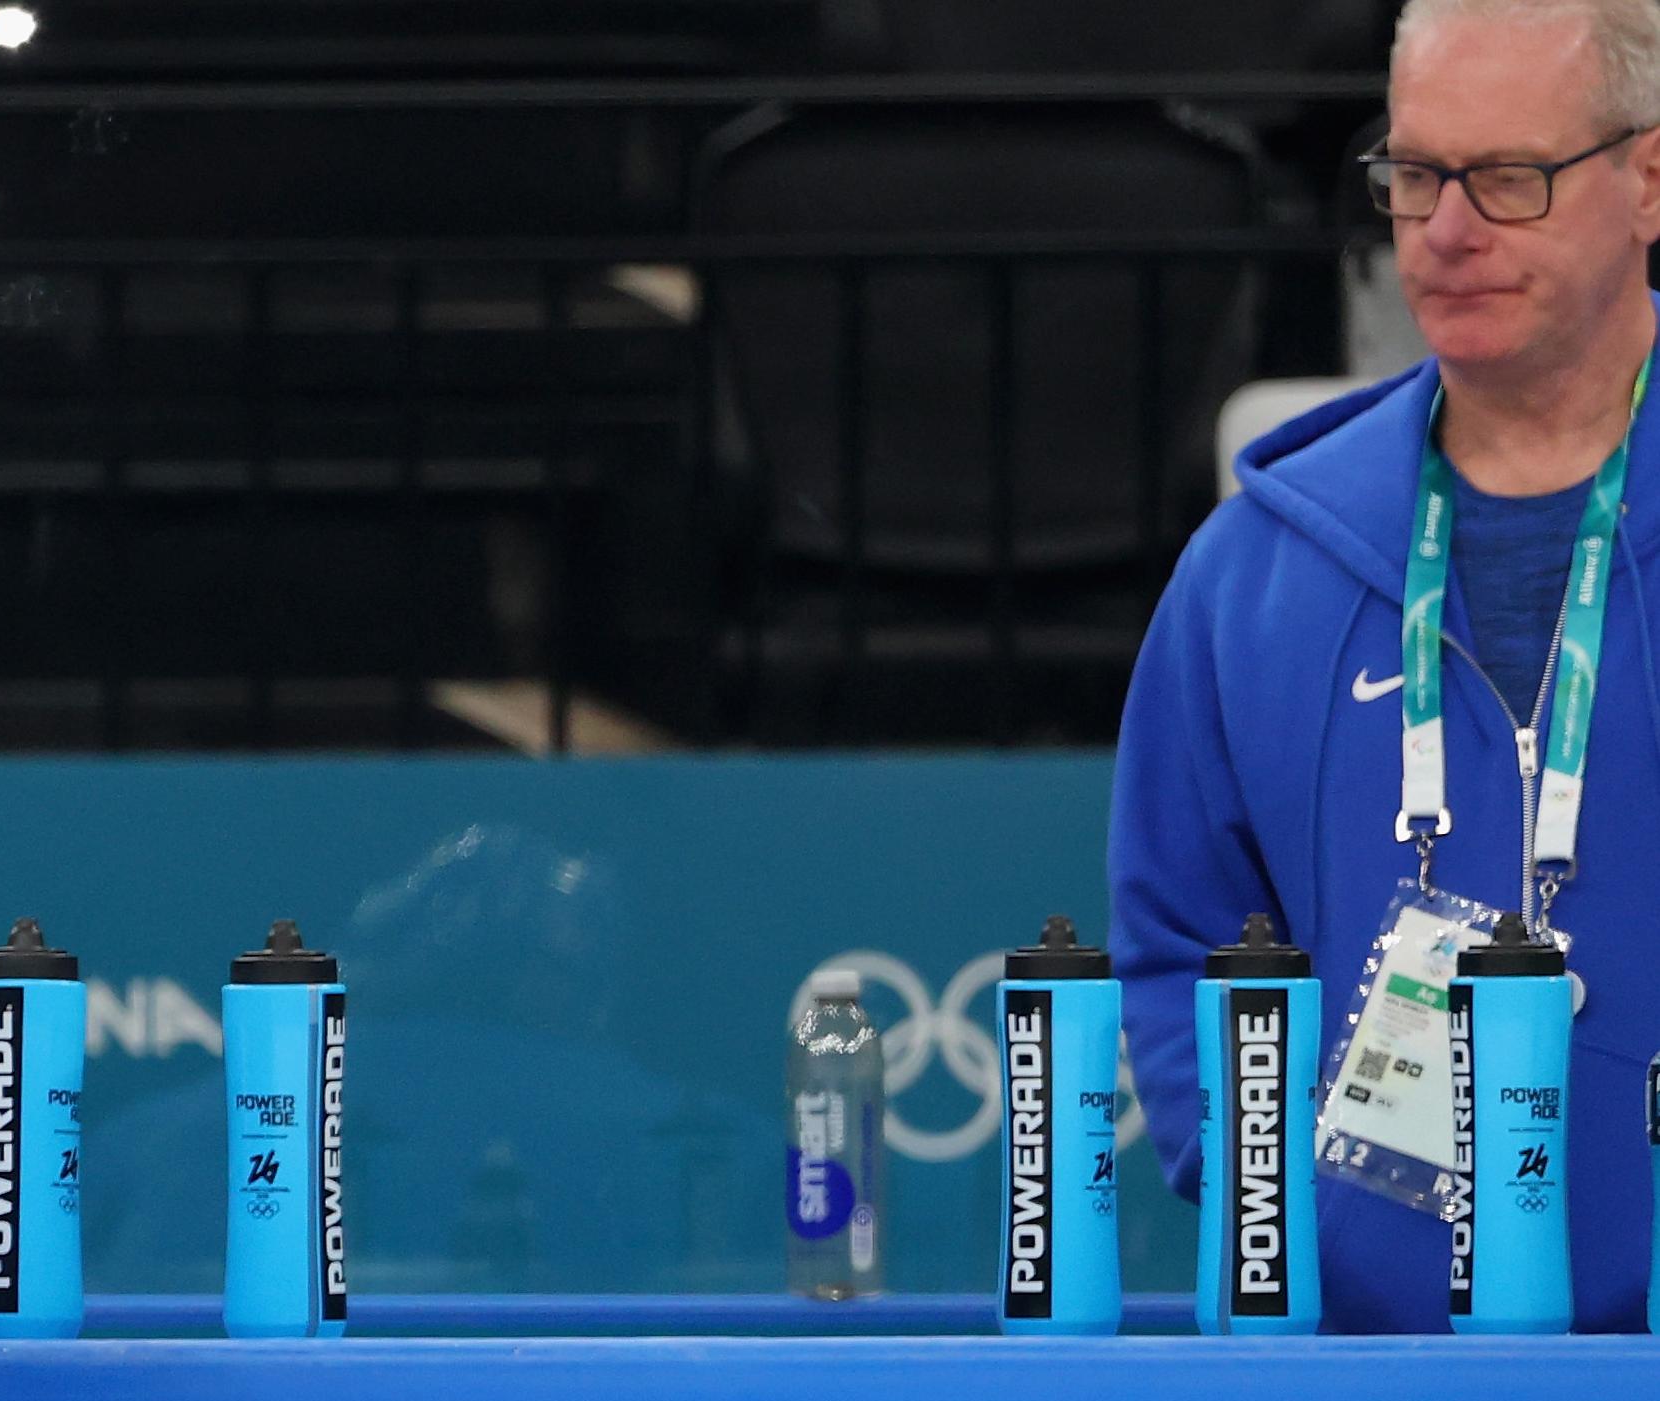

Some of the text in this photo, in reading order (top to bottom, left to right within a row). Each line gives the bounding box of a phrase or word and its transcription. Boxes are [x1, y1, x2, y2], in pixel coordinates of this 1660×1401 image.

[235, 1093, 296, 1111] POWER
[260, 1110, 300, 1127] ADE
[324, 1016, 346, 1296] POWERADE
[795, 1090, 828, 1224] smart
[1010, 1010, 1044, 1294] POWERADE
[1240, 1010, 1280, 1294] POWERADE
[1449, 1009, 1474, 1291] POWERADE
[1500, 1087, 1561, 1104] POWER
[1530, 1104, 1561, 1120] ADE
